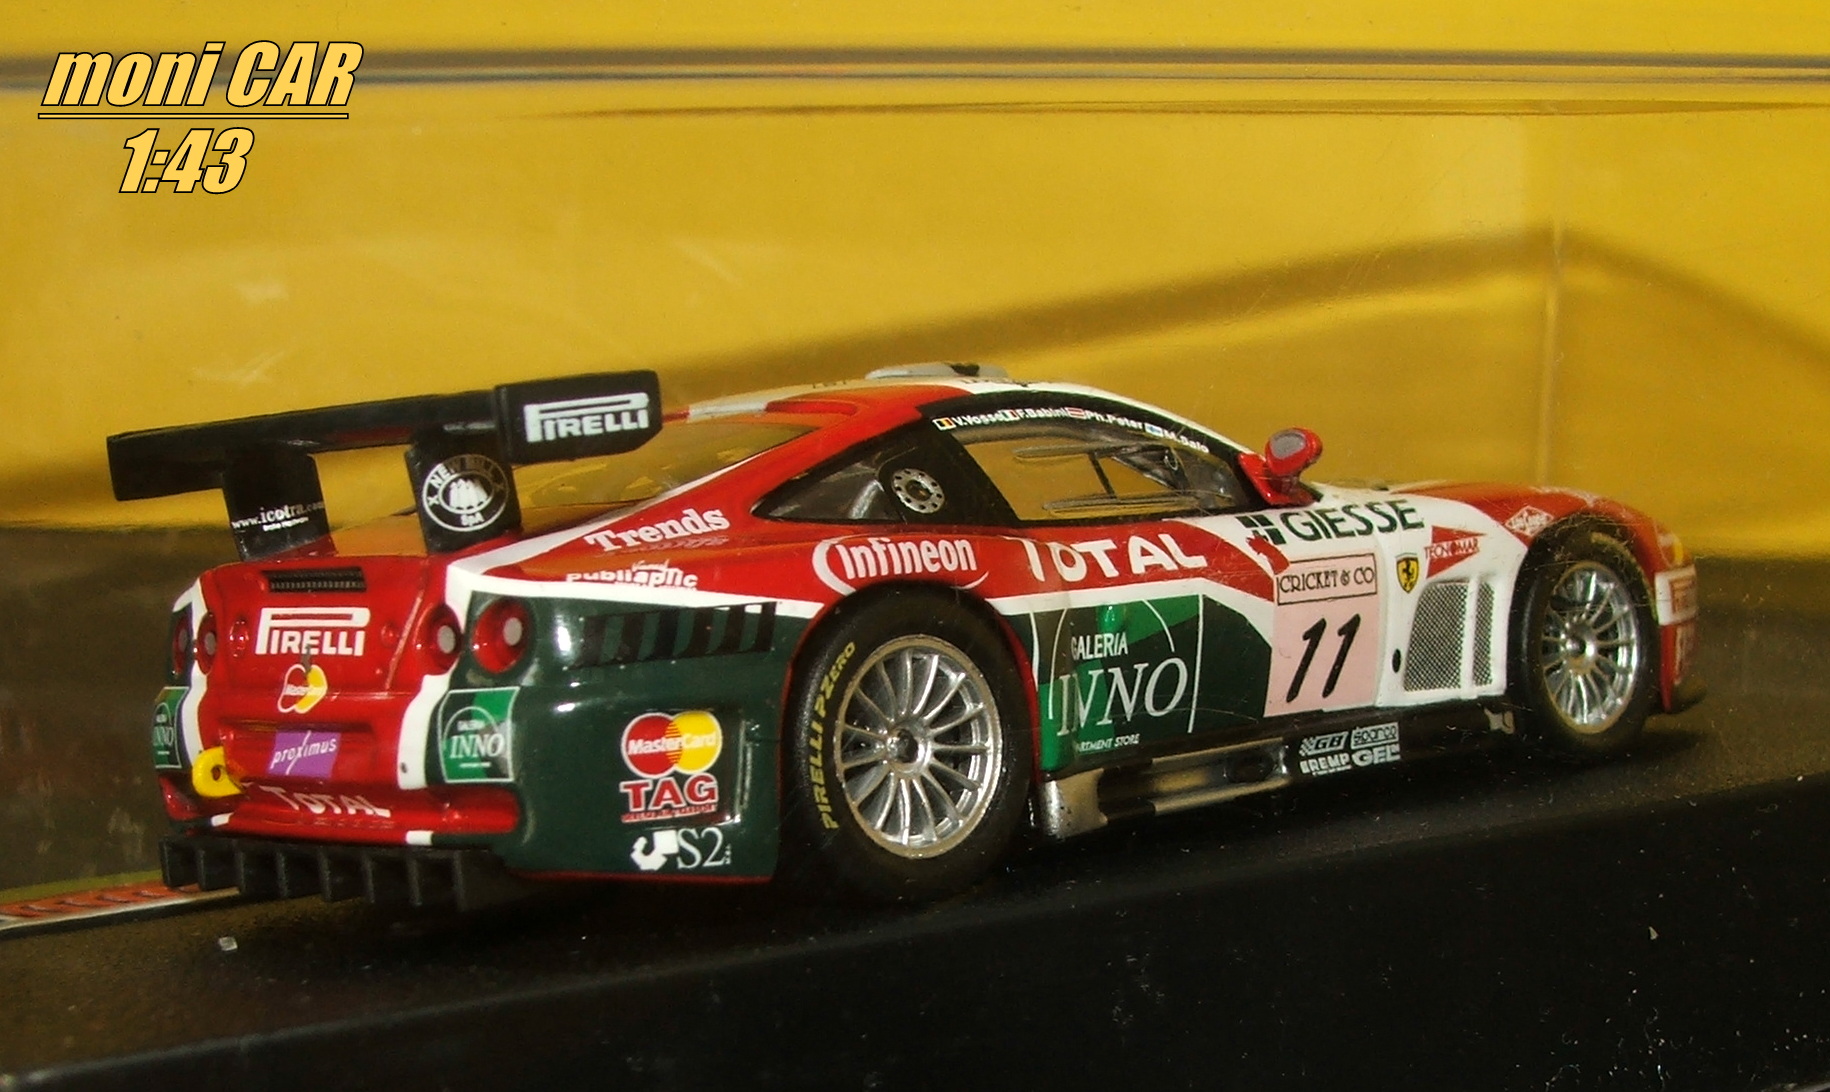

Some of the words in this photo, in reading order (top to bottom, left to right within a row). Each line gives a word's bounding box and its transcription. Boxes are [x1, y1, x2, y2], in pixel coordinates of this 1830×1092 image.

[524, 392, 650, 443] PIRELLI
[583, 508, 731, 552] Trends
[1279, 500, 1425, 541] GIESSE
[836, 537, 977, 580] Infineon
[1004, 533, 1208, 583] TOTAL
[1279, 570, 1337, 594] CRICKET
[1353, 566, 1375, 584] CO
[255, 607, 370, 656] PIRELLI
[1071, 632, 1128, 660] GALERIA
[1286, 613, 1361, 703] 11
[1057, 657, 1188, 736] INNO
[270, 730, 337, 775] proximus
[450, 733, 505, 759] INNO
[619, 772, 719, 812] TAG
[810, 719, 839, 829] PIRELLI
[259, 785, 391, 818] TOTAL
